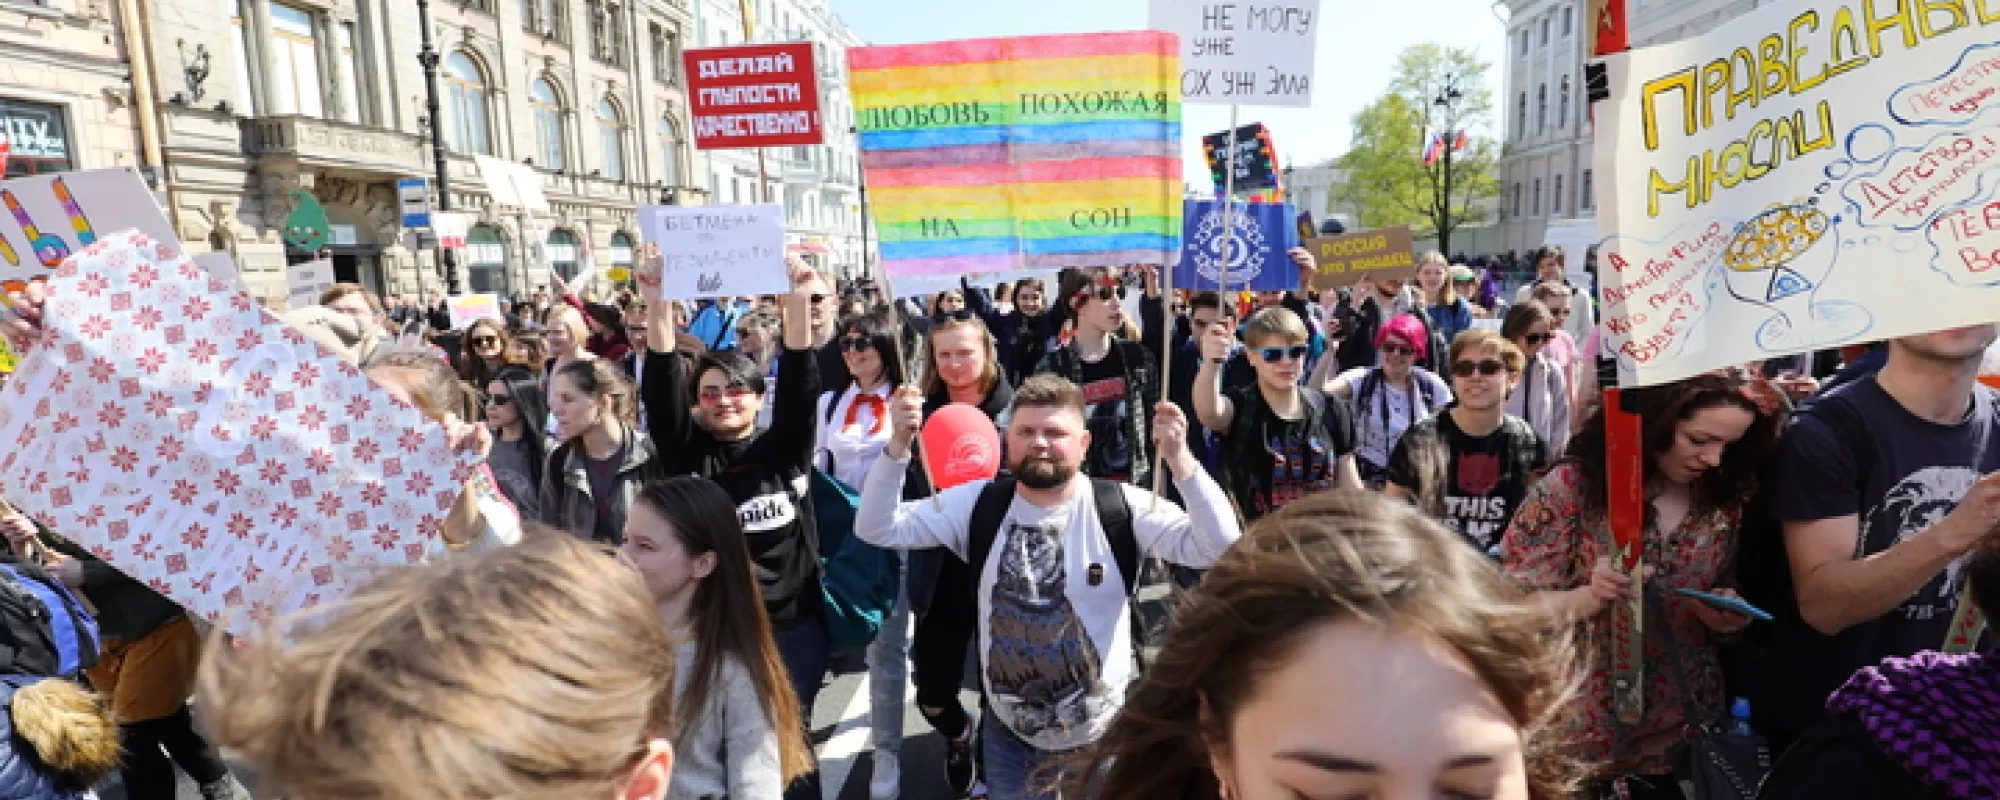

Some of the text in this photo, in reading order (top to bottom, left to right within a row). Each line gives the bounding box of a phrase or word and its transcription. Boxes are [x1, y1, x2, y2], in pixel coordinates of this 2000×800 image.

[1202, 4, 1312, 35] НЕ МОГУ
[1191, 36, 1234, 58] УЖЕ
[697, 52, 796, 79] ДЕЛАЙ
[697, 83, 801, 106] ГЛУПОСТИ
[1221, 71, 1256, 97] УЖ
[863, 90, 1168, 131] ЛЮБОВЬ ПОХОЖАЯ
[1647, 100, 1836, 218] МЮСЛИ
[919, 207, 1132, 238] НА СОН
[1321, 235, 1387, 257] РОССИЯ
[1444, 496, 1506, 519] THIS
